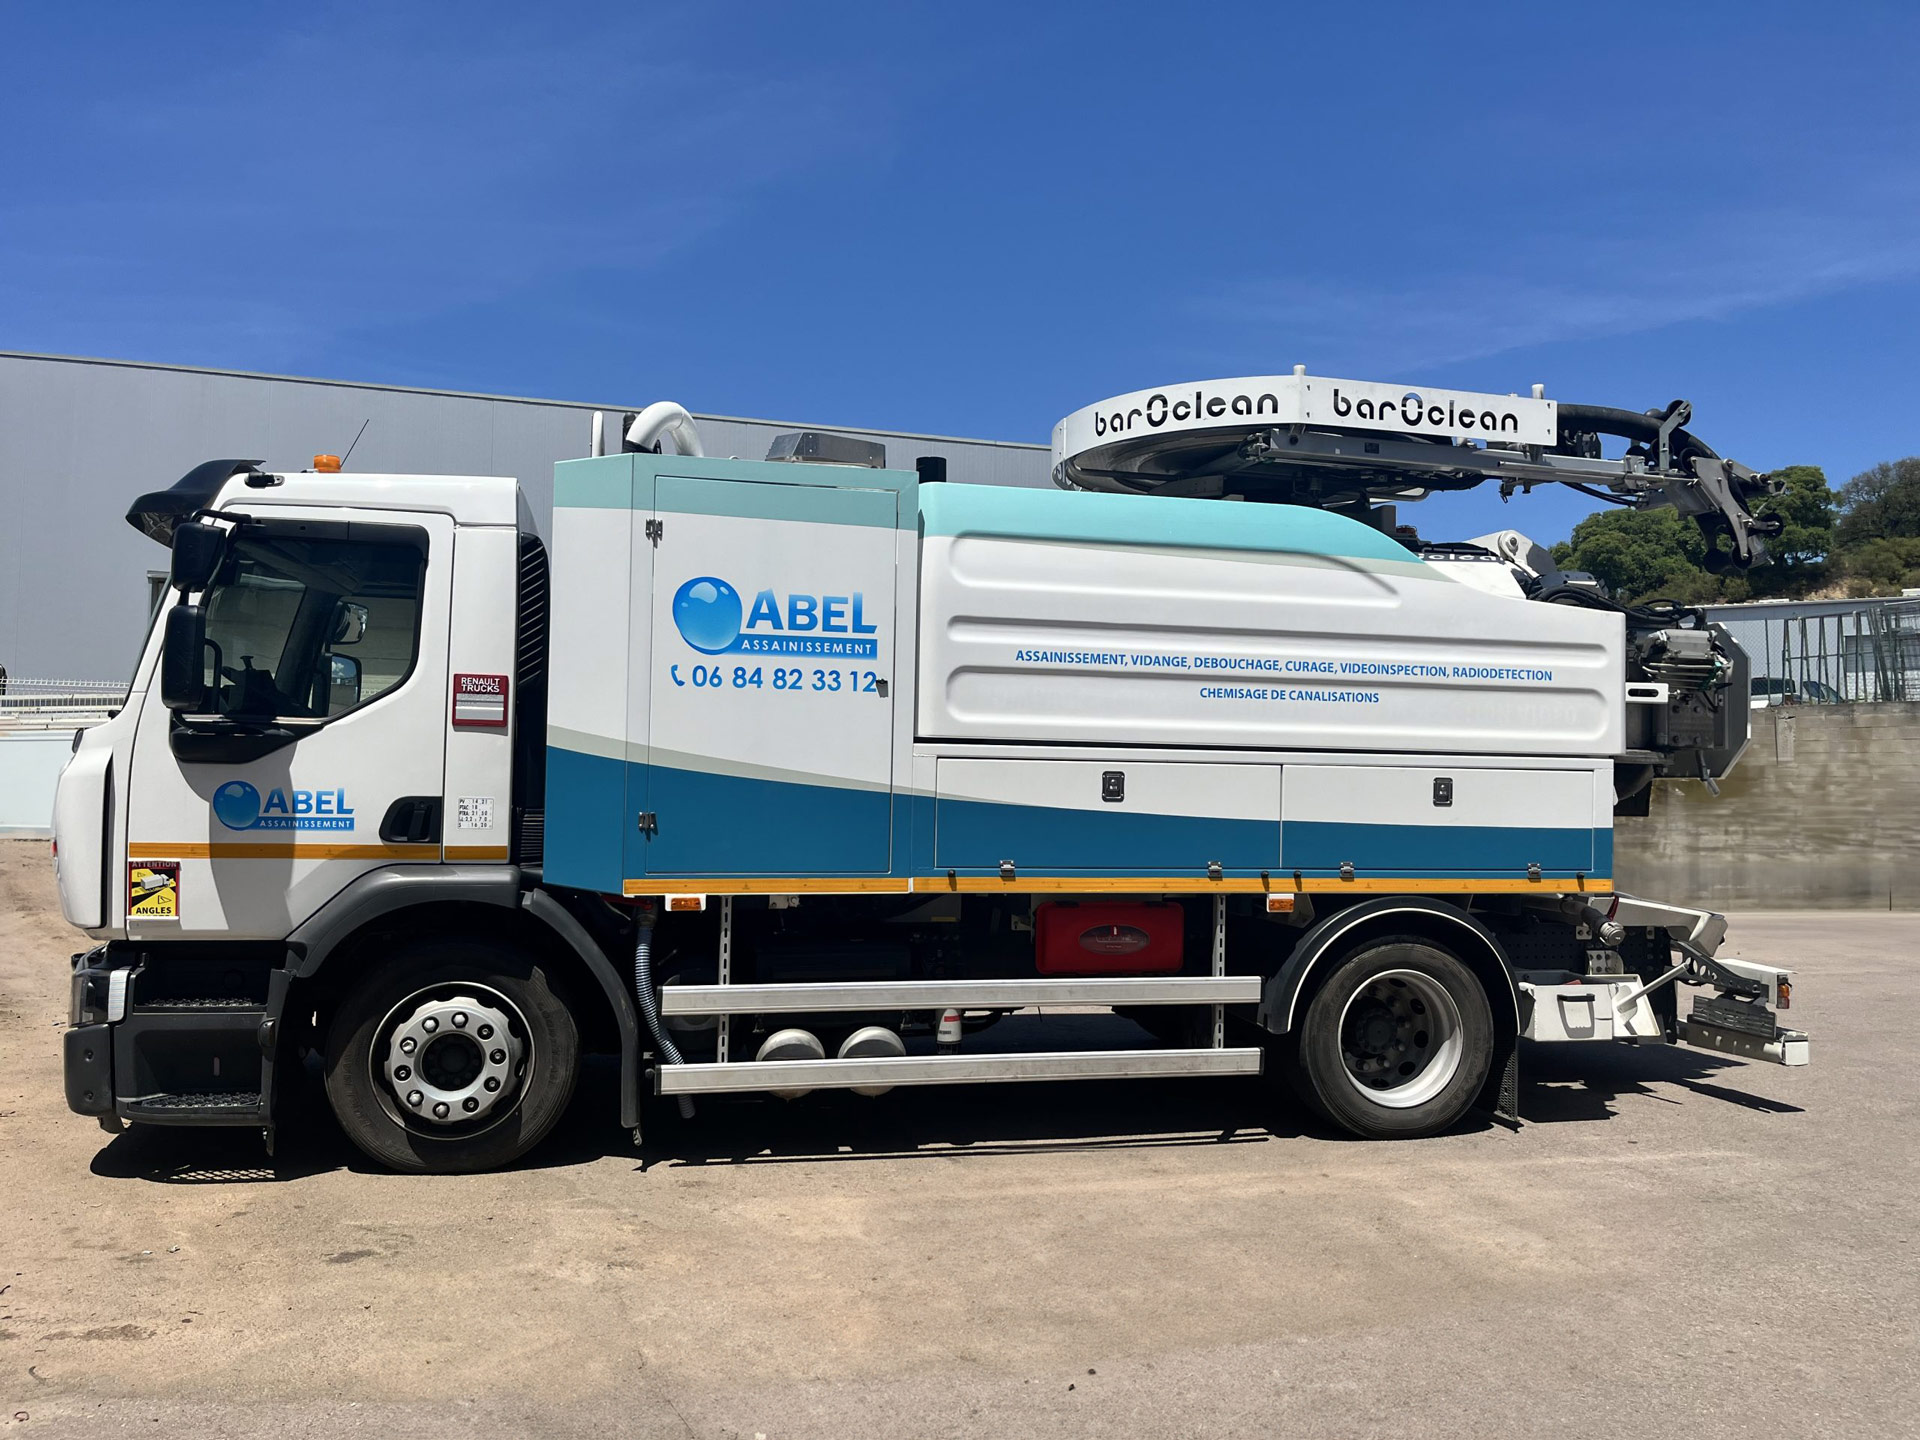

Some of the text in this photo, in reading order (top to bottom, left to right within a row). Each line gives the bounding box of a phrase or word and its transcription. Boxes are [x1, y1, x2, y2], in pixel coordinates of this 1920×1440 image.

[746, 588, 878, 634] ABEL
[741, 639, 872, 655] ASSAINISSEMENT
[1015, 650, 1552, 681] ASSAINISSEMENT, VIDANGE, DEBOUCHAGE, CURAGE, VIDEOINSPECTION, RADIODETECTION
[461, 677, 500, 685] RENAULT
[692, 665, 877, 692] 06 84 82 33 12
[461, 684, 500, 693] TRUCKS
[1200, 687, 1380, 703] CHEMISAGE DE CANALISATIONS
[263, 787, 355, 815] ABEL
[260, 820, 351, 828] ASSAINISSEMENT
